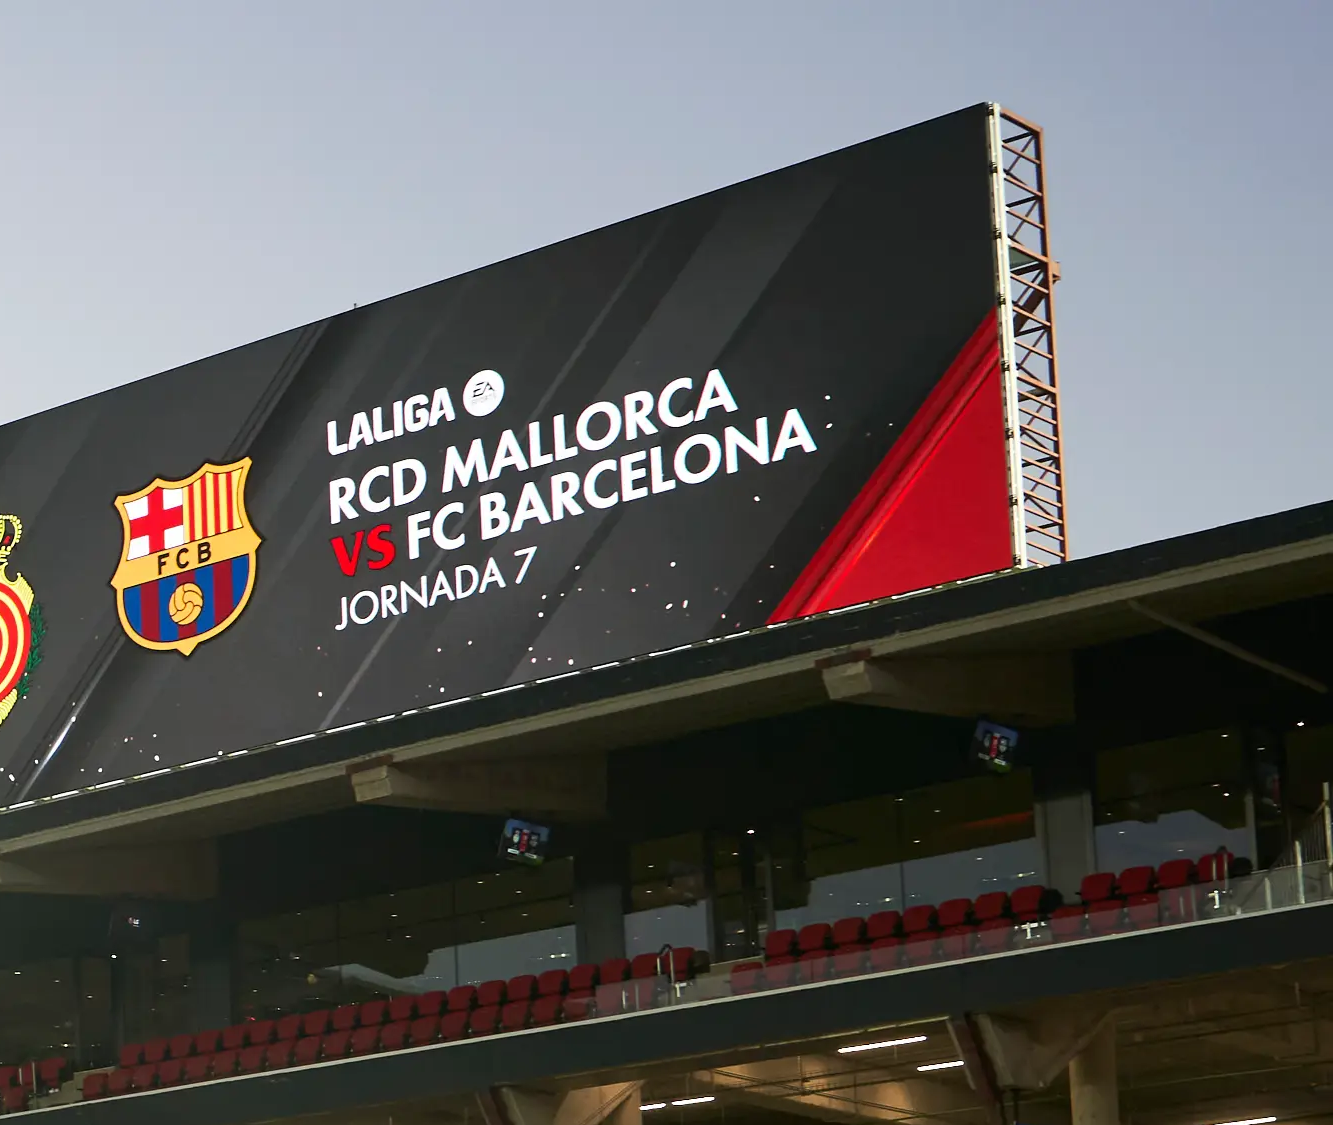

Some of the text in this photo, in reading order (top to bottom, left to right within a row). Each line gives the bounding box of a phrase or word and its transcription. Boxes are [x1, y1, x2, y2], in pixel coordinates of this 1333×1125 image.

[327, 387, 455, 456] LALIGA
[329, 368, 738, 524] RCD MALLORCA
[330, 408, 817, 577] VS FC BARCELONA
[158, 541, 212, 575] FCB
[334, 546, 537, 631] JORNADA 7
